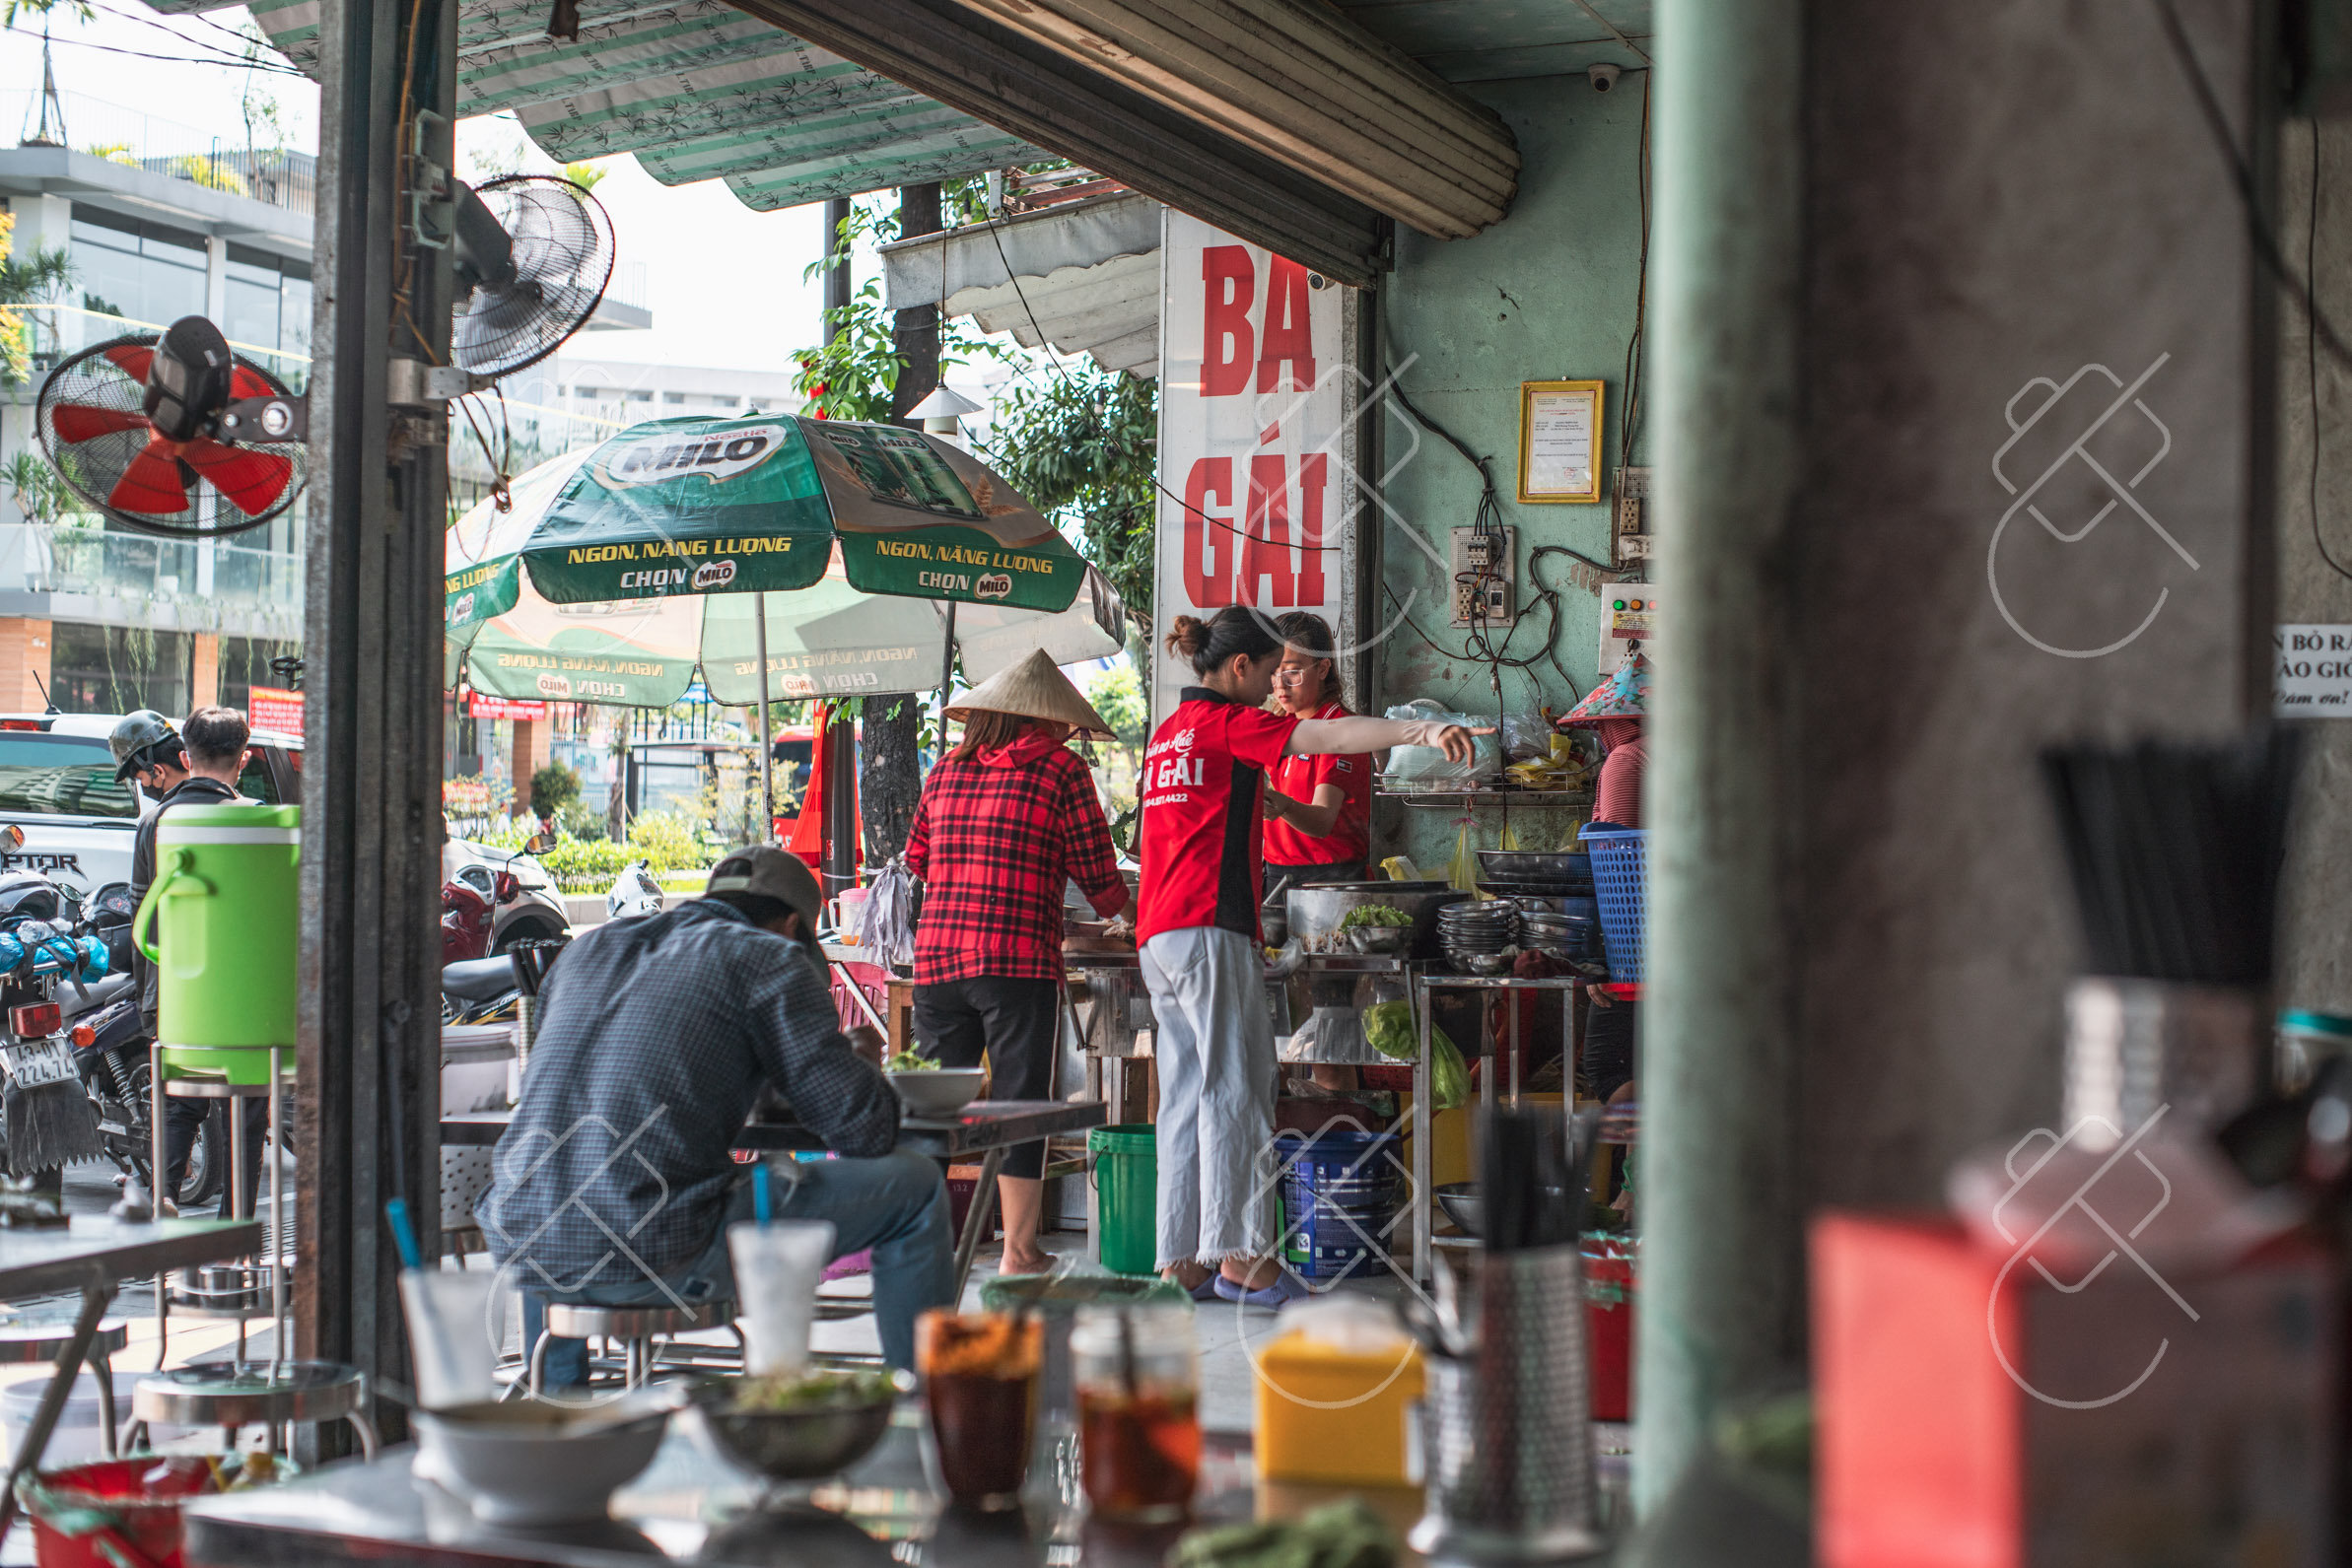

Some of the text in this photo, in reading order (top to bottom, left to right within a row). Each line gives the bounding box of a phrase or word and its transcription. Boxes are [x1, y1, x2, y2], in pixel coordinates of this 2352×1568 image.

[621, 437, 768, 474] MILO
[1183, 420, 1328, 608] GÁI
[568, 544, 639, 565] NGON,
[875, 540, 933, 562] NGON,
[935, 545, 989, 566] NĂNG
[620, 568, 732, 591] CHỌN MILO
[919, 572, 1008, 594] CHỌN MILO
[1157, 752, 1205, 788] GÁI
[18, 1058, 75, 1085] 224.74
